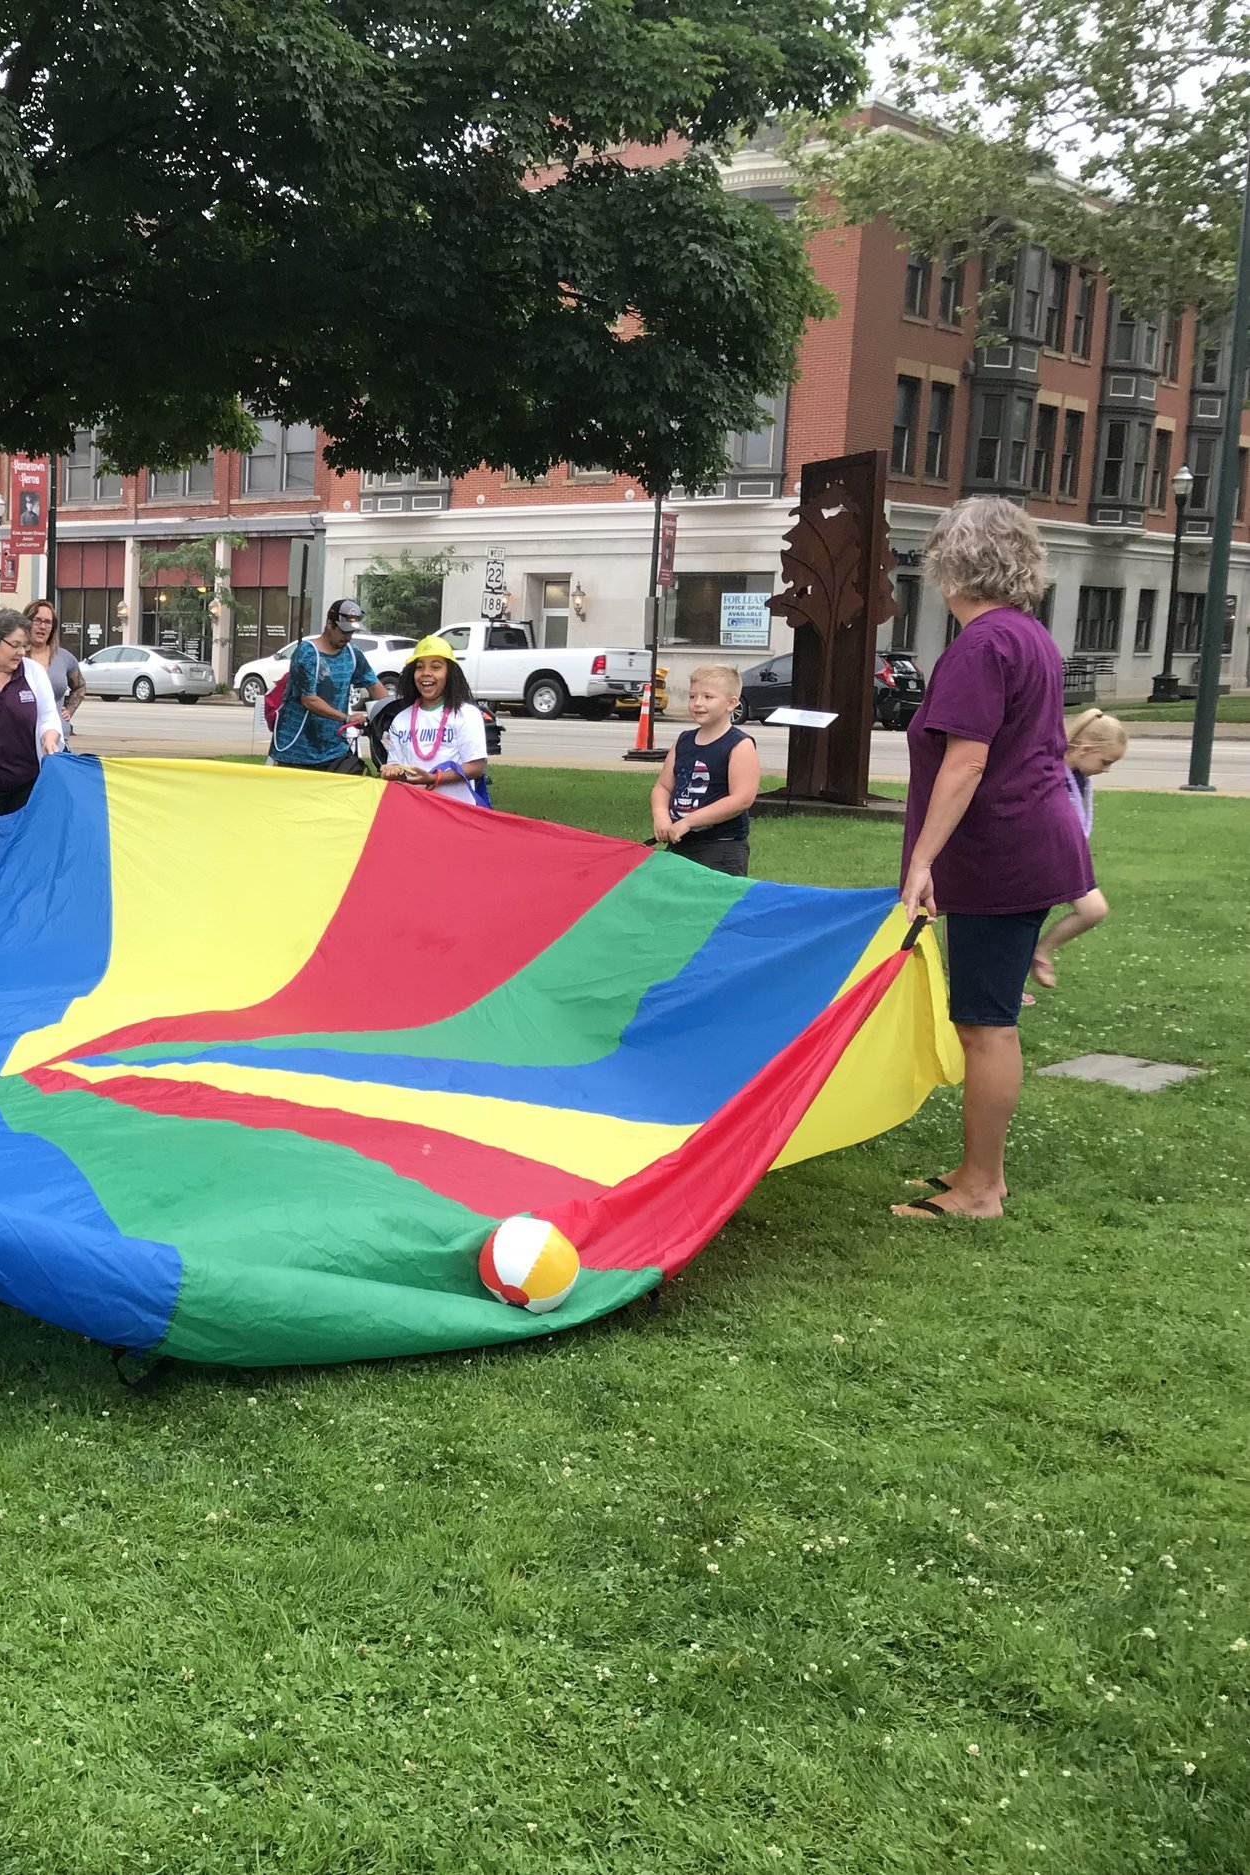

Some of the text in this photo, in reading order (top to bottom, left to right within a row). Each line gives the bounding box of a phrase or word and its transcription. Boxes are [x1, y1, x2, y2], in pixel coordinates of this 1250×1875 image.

[11, 459, 45, 474] Hometown
[488, 567, 501, 582] 22
[485, 597, 501, 611] 188
[723, 595, 741, 604] FOR
[419, 728, 453, 743] UNIED
